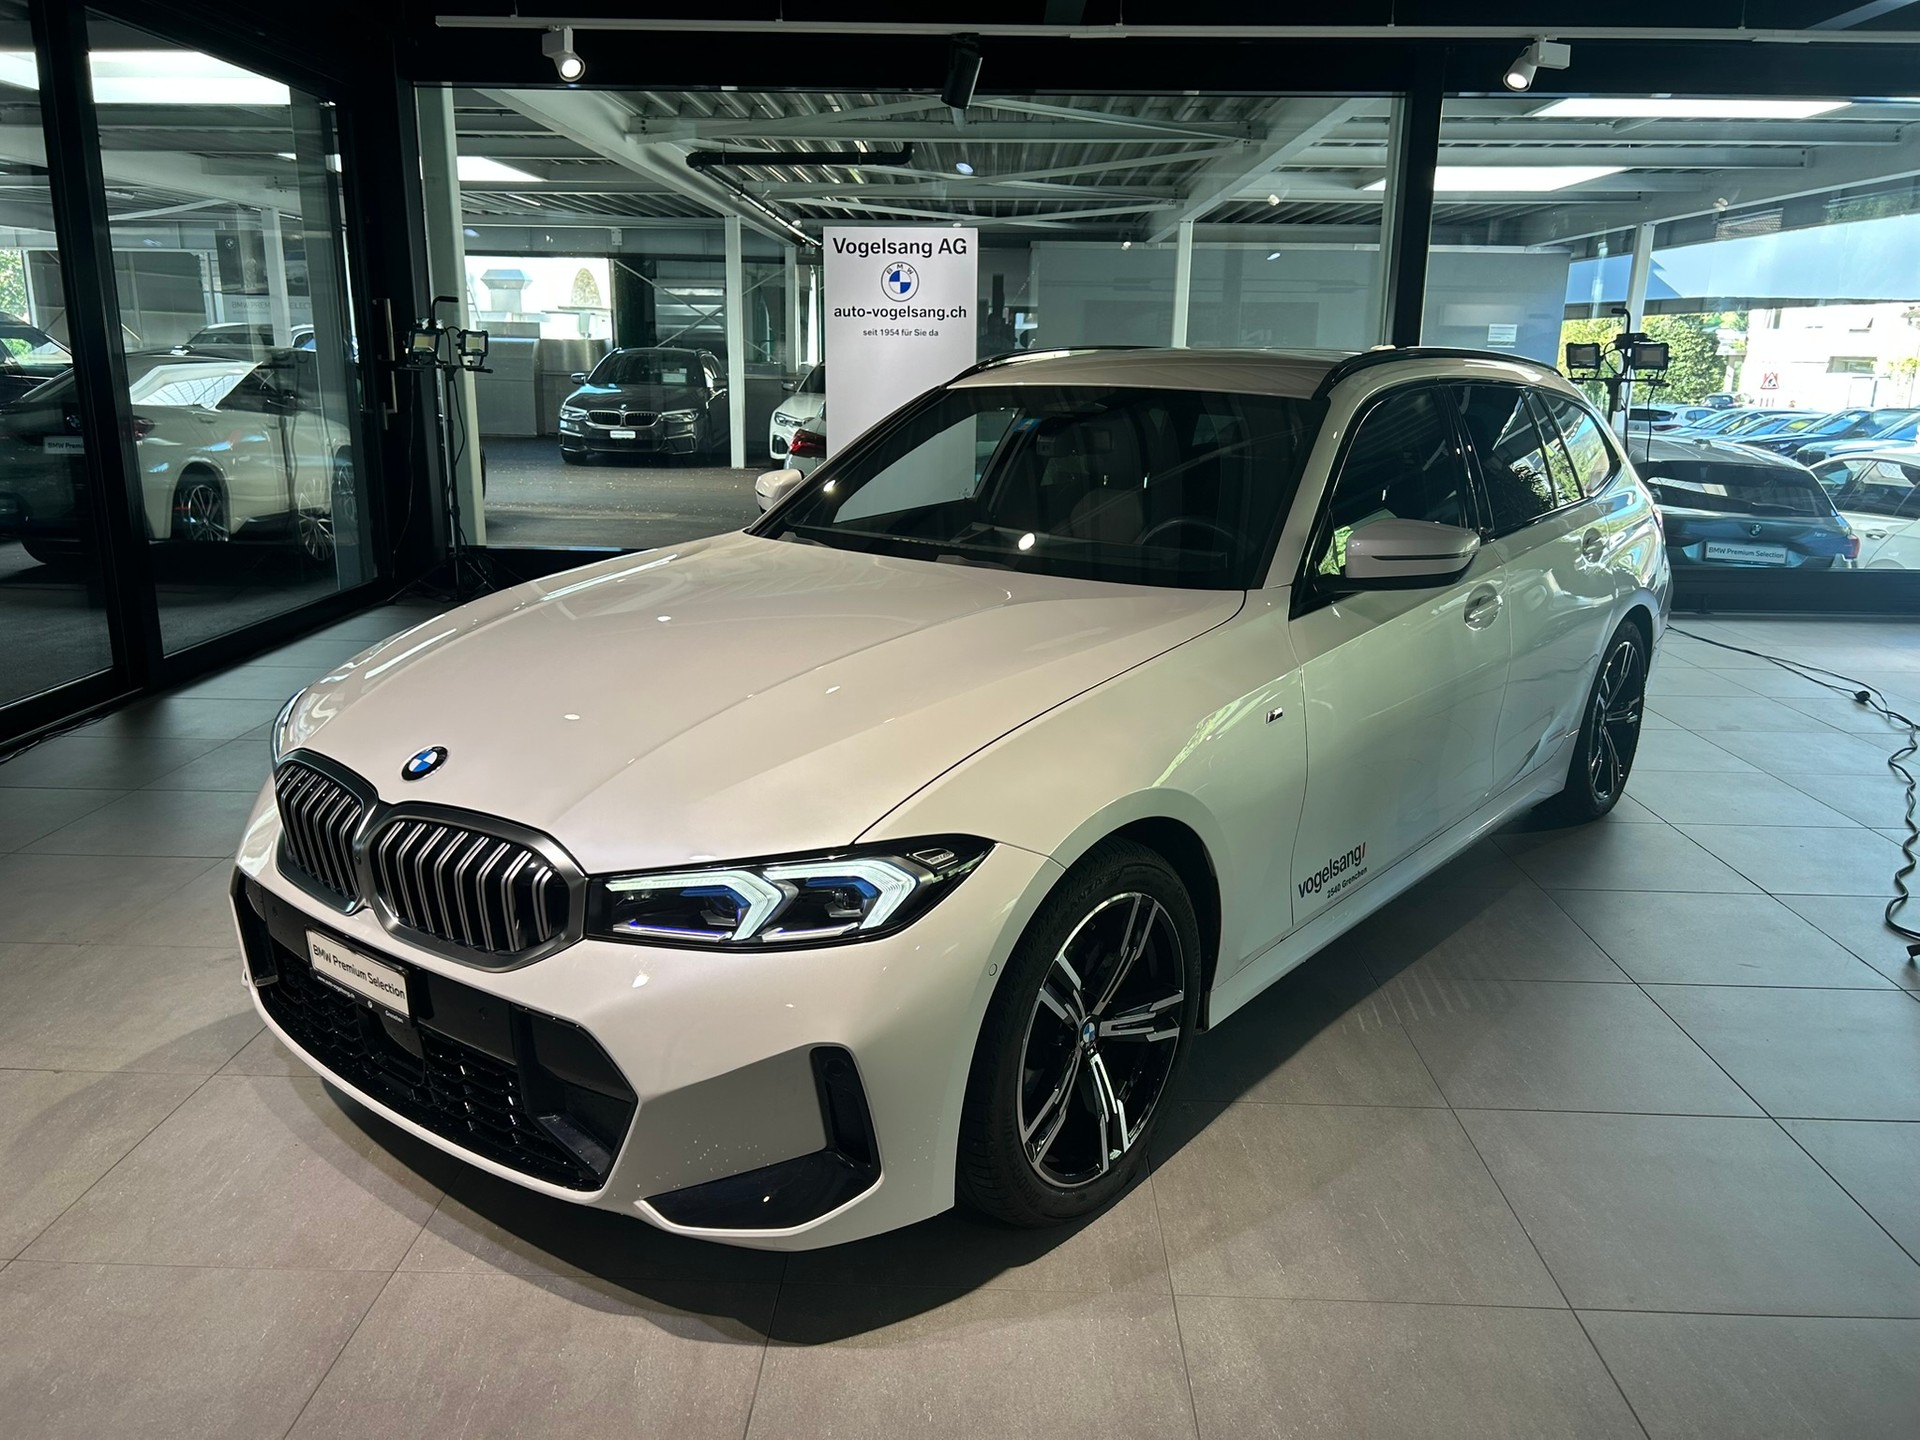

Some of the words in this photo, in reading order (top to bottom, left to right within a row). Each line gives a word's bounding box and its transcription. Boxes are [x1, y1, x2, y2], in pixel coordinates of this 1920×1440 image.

[833, 238, 932, 258] Vogelsang
[938, 238, 967, 254] AG
[886, 263, 913, 275] BMW
[834, 305, 967, 320] auto-vogelsang.ch
[901, 328, 913, 337] für
[914, 329, 927, 337] Sie
[928, 329, 939, 337] da
[1708, 546, 1726, 554] BMW
[1727, 548, 1755, 556] Premium
[1756, 550, 1784, 558] Selection
[312, 944, 332, 964] BMW
[333, 955, 367, 981] Premium
[367, 972, 405, 1000] Selection
